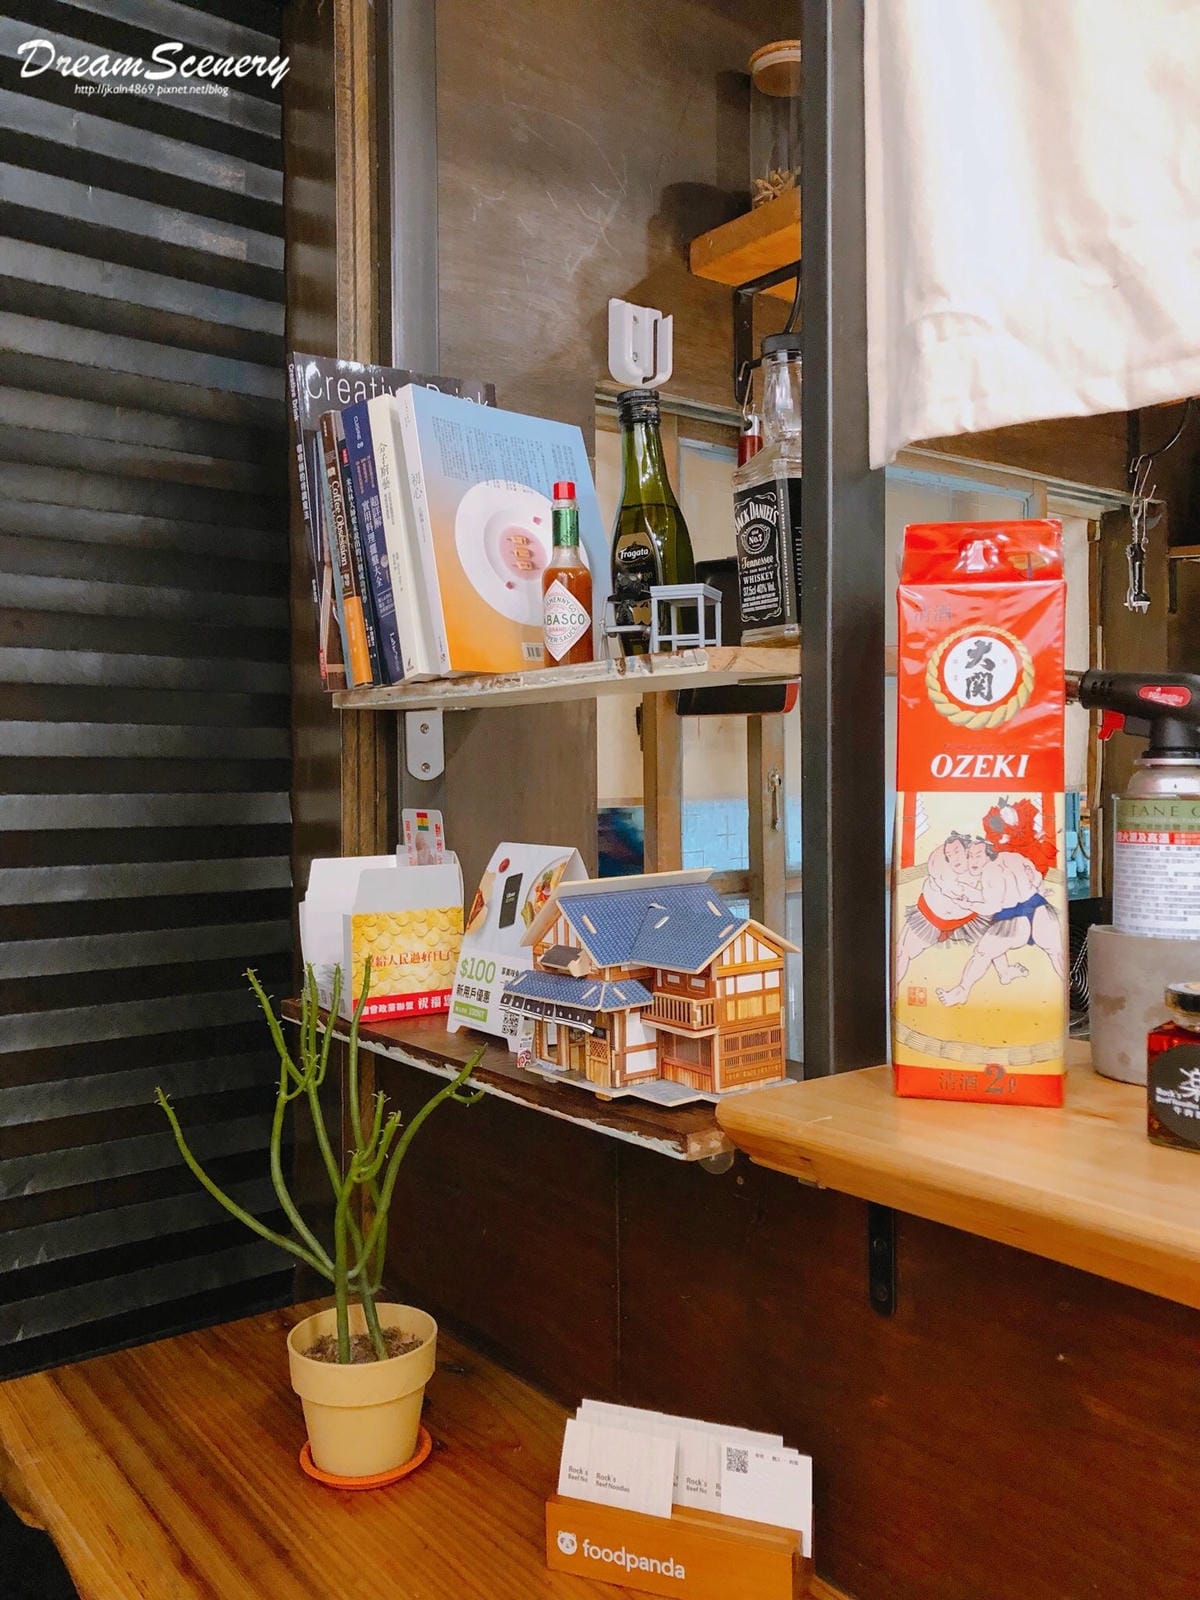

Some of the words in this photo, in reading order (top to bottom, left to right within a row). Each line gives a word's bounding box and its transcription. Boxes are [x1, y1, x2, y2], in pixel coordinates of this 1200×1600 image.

[305, 361, 400, 404] Creativ
[331, 480, 341, 510] Coffee
[336, 514, 348, 566] Obsession
[749, 501, 779, 528] DANIEL'S
[741, 555, 774, 569] Tennessee
[743, 571, 774, 585] WHISKEY
[930, 753, 1030, 779] OZEKI
[460, 957, 497, 984] $100
[457, 983, 491, 1004] 新用戶優惠
[582, 1538, 686, 1580] foodpanda
